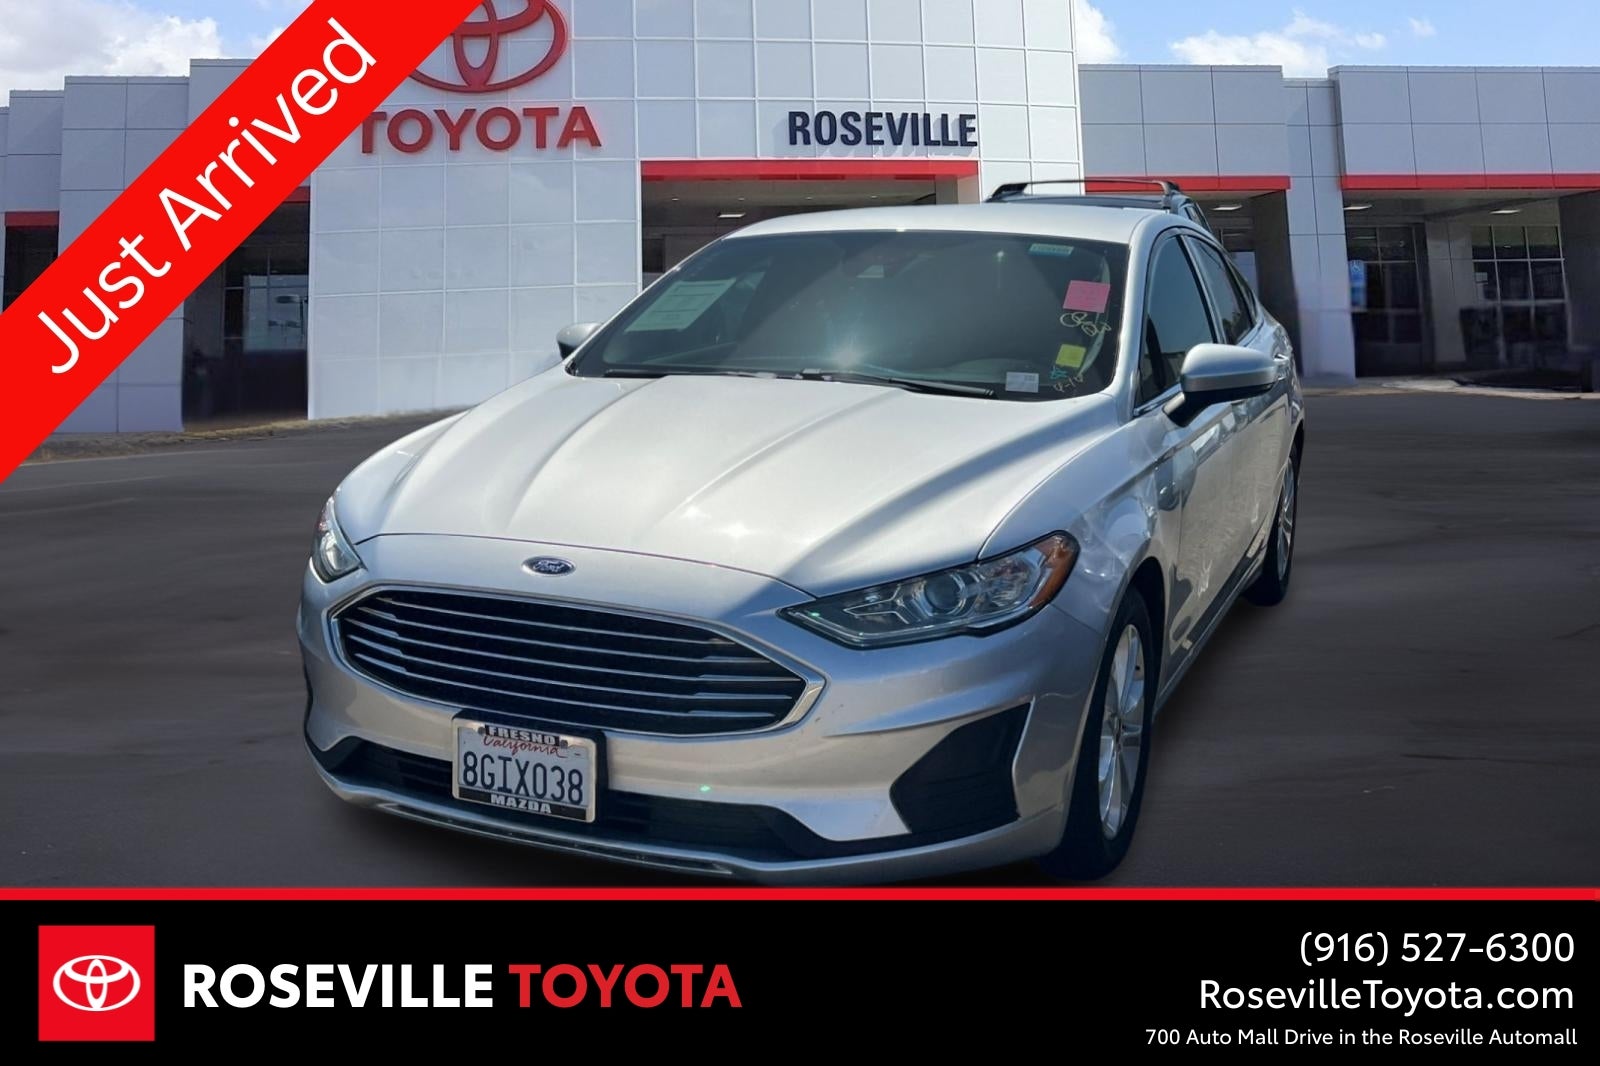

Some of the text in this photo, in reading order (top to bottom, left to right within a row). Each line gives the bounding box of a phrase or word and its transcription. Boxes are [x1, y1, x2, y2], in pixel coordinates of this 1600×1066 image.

[361, 106, 602, 154] TOYOTA
[788, 111, 978, 147] ROSEVILLE
[488, 725, 557, 746] FRESNO
[462, 750, 584, 805] 8GIX038
[490, 793, 552, 815] MAZDA
